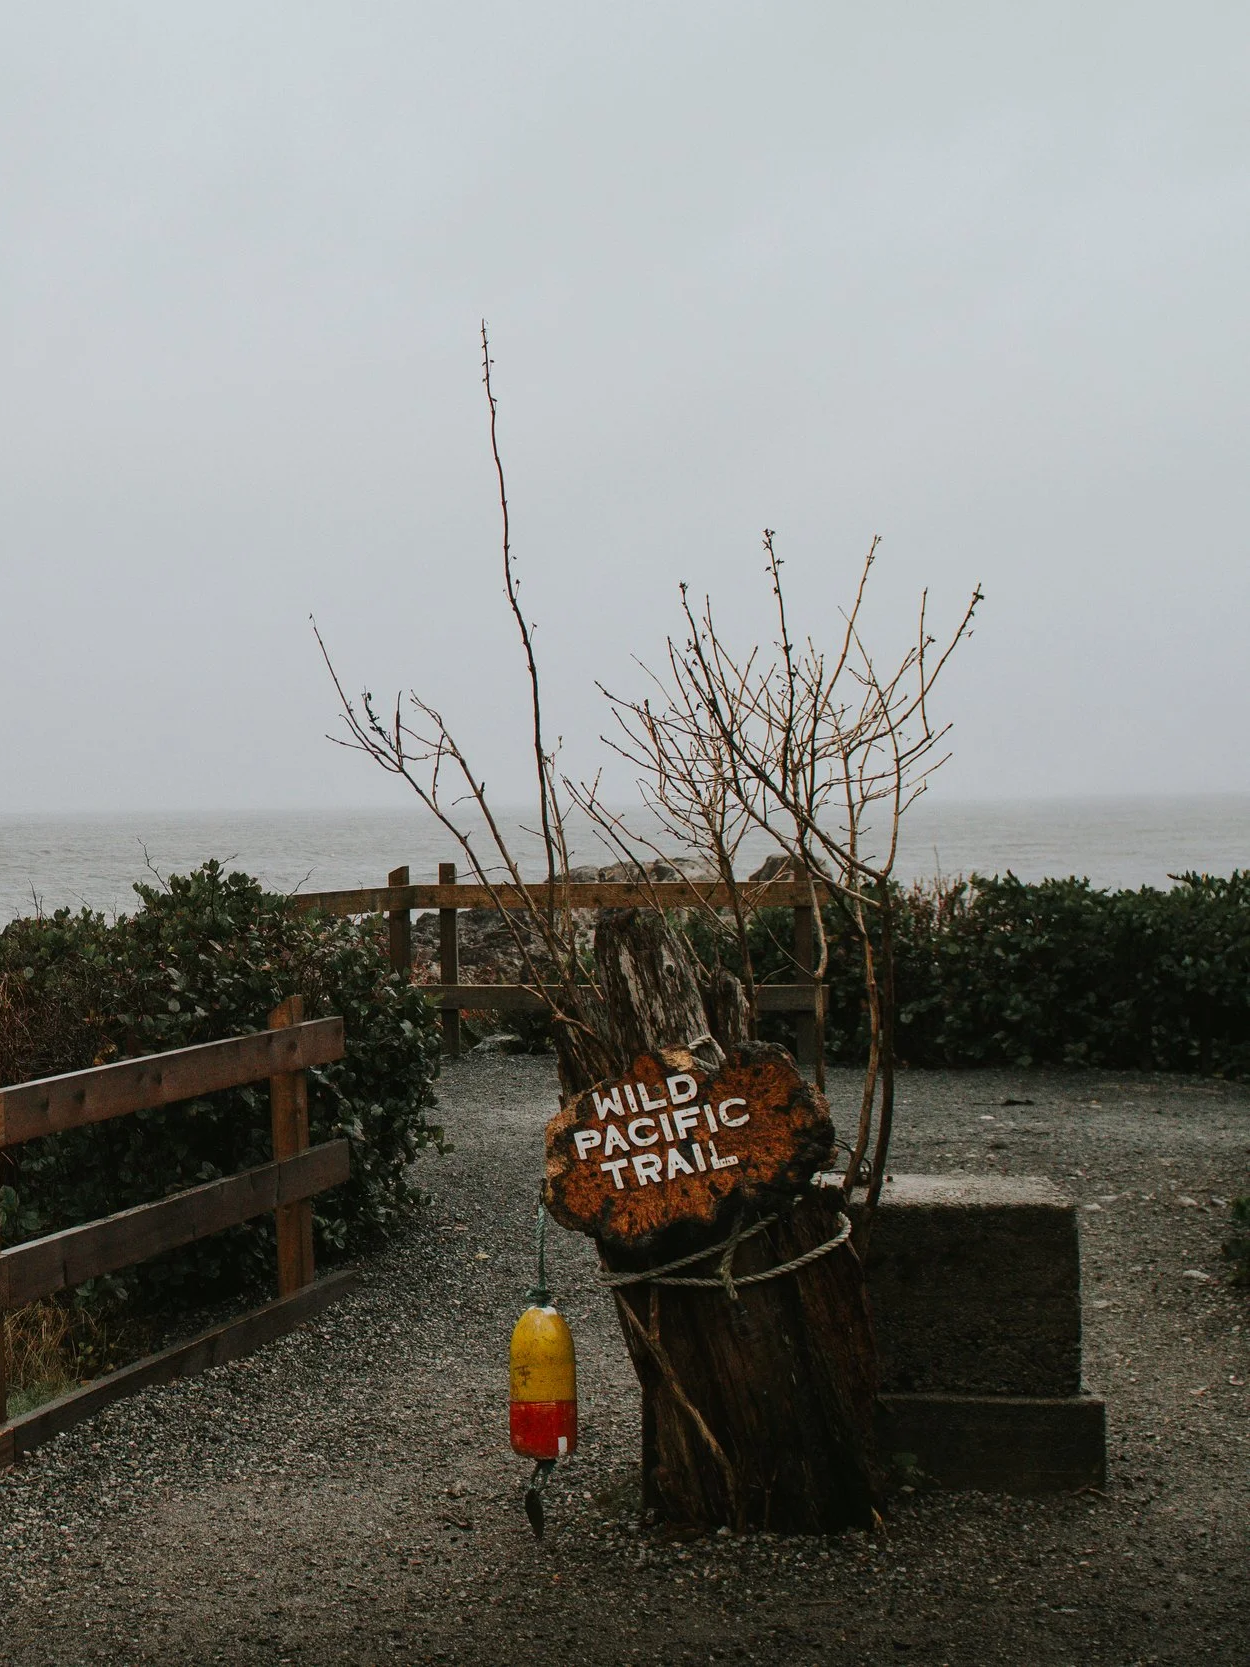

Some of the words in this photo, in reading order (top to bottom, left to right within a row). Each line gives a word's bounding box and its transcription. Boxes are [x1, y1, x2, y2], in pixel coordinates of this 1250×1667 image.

[592, 1074, 698, 1120] WILD
[574, 1097, 750, 1160] PACIFIC
[600, 1140, 739, 1190] TRAIL
